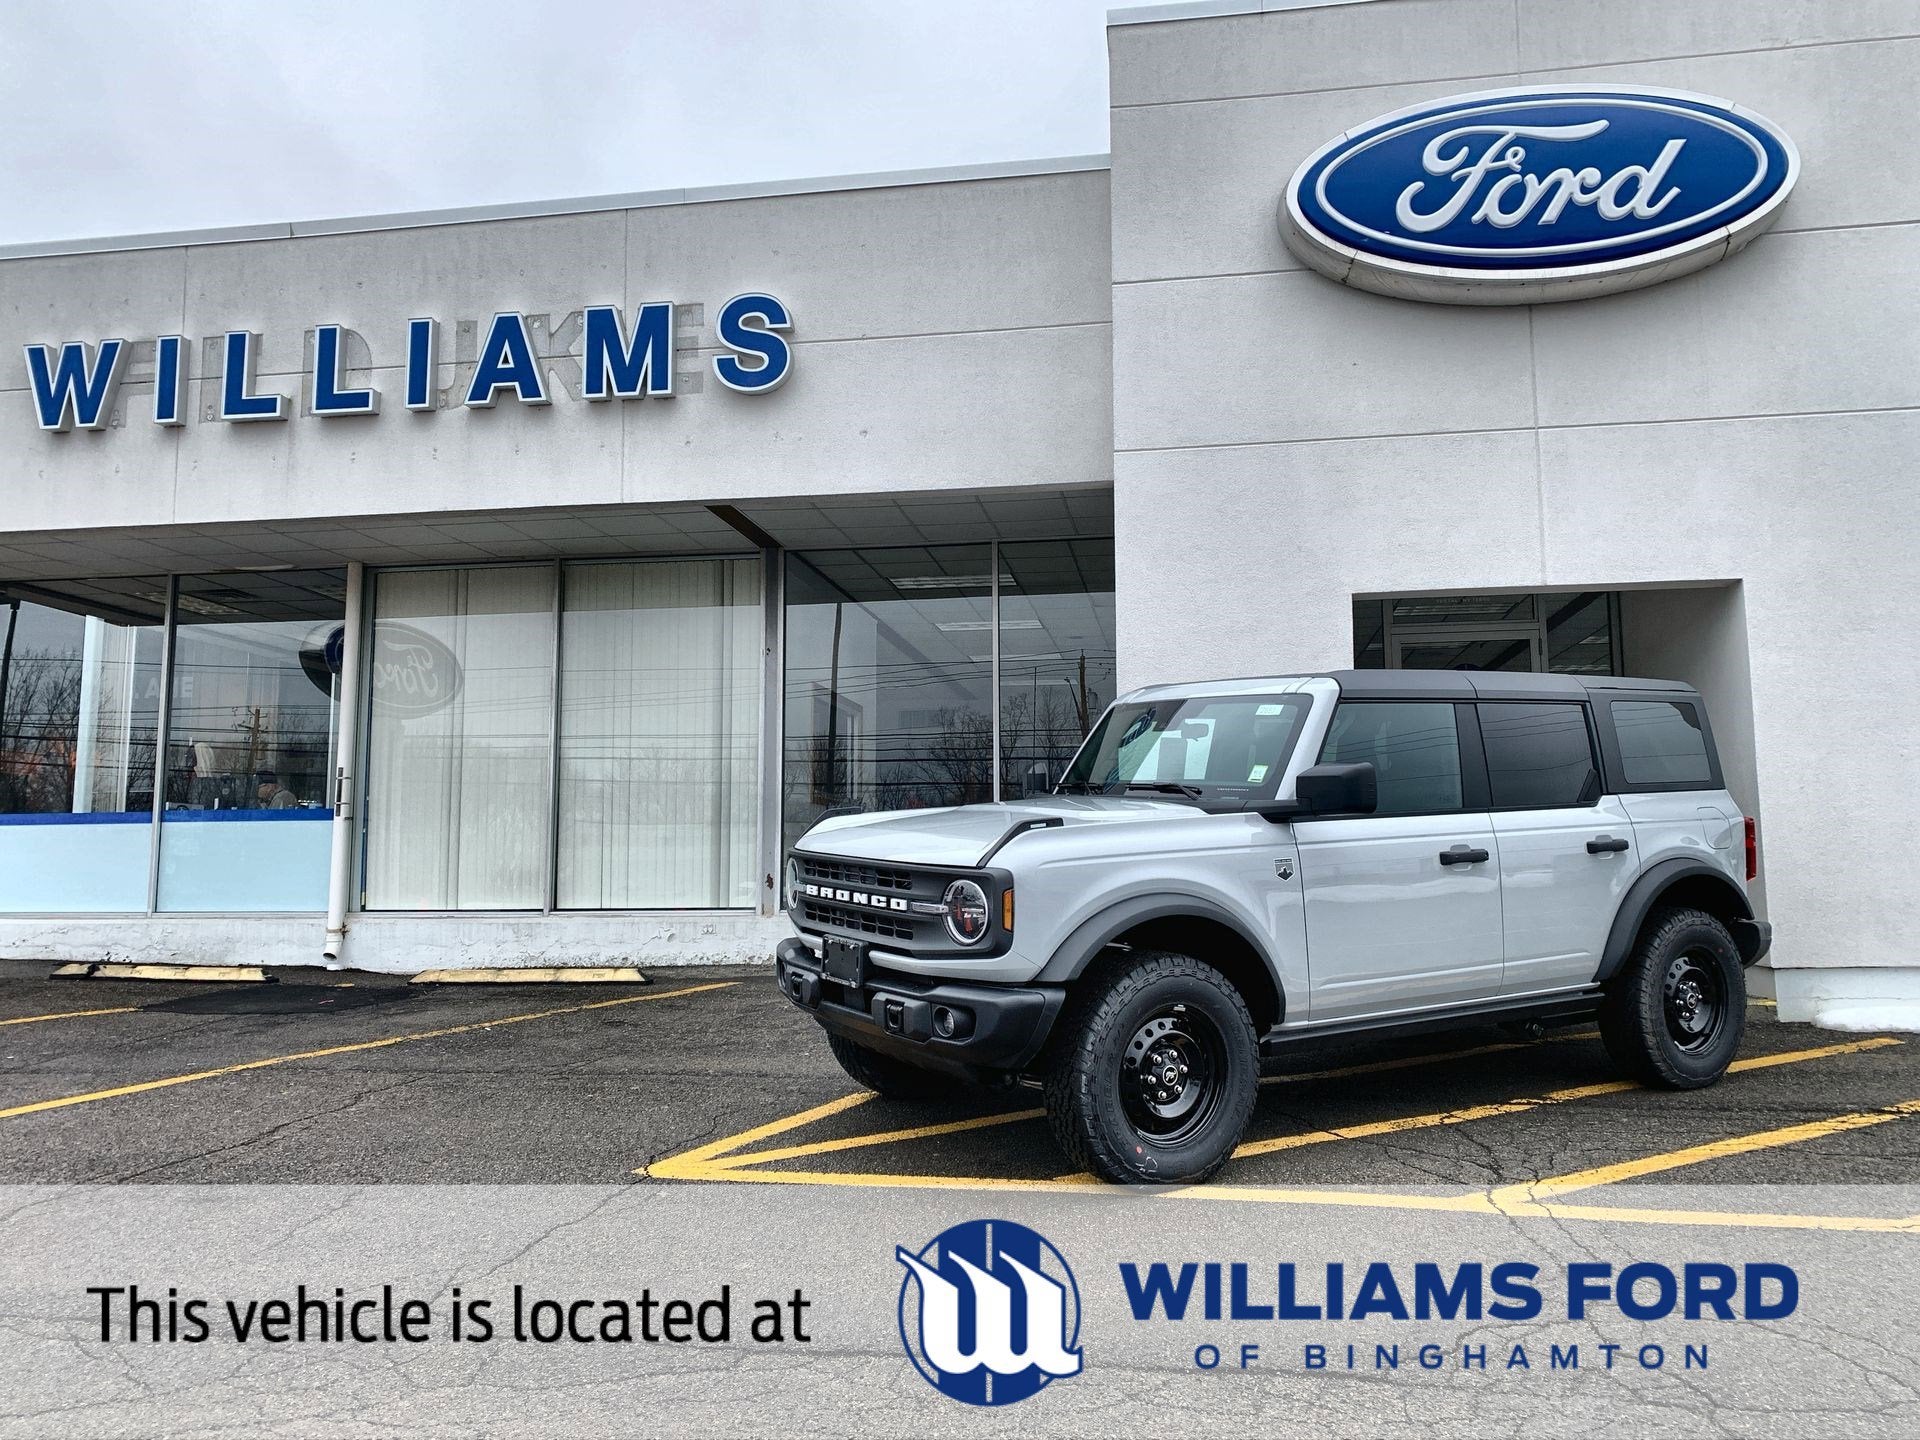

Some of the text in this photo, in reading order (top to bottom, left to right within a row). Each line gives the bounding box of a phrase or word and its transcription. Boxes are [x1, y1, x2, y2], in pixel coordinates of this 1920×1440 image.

[1396, 119, 1687, 234] Ford
[24, 292, 795, 433] WILLIAMS
[806, 884, 907, 911] BRONCO
